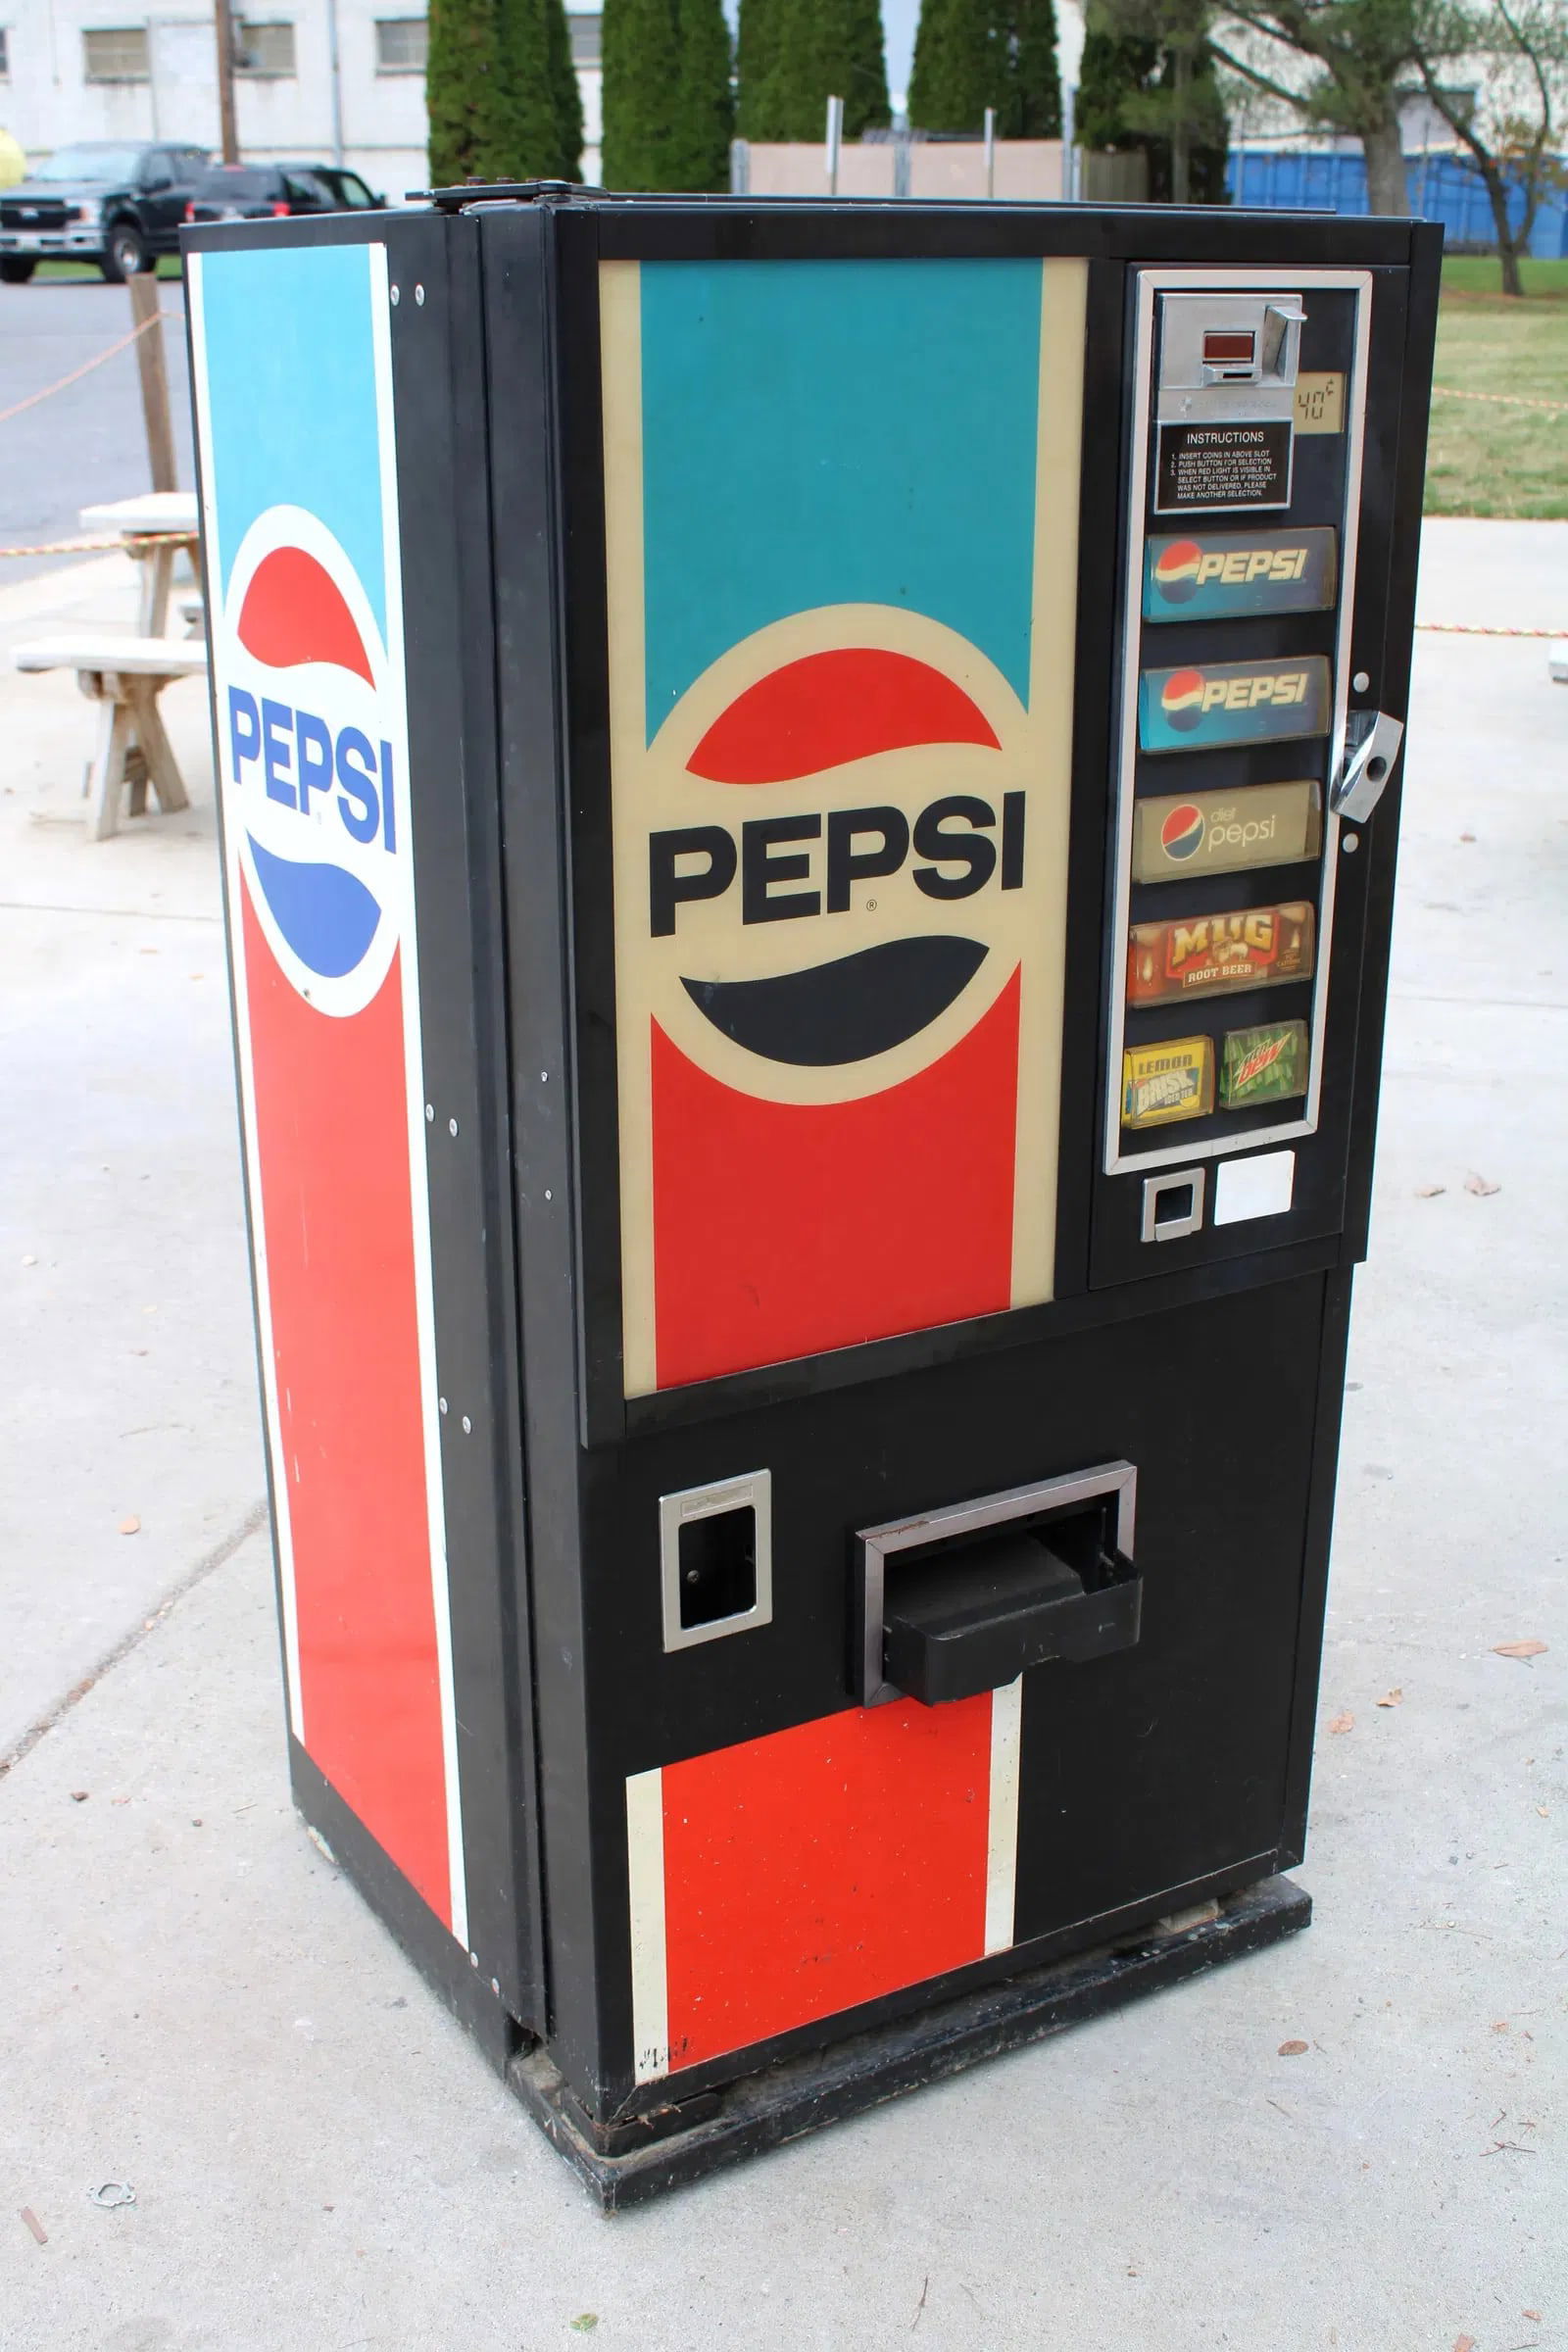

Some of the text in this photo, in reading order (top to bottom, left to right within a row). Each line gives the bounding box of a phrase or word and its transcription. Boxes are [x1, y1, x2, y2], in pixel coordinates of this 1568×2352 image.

[1187, 431, 1264, 445] INSTRUCTIONS
[1197, 459, 1223, 467] BUTTON
[1238, 458, 1272, 466] SELECTION
[1232, 450, 1252, 459] ABOVE
[1177, 475, 1201, 484] SELECT
[1230, 473, 1240, 482] OR
[1248, 472, 1277, 481] PRODUCT
[1244, 480, 1267, 489] PLEASE
[1196, 490, 1226, 499] ANOTHER
[1196, 548, 1308, 586] PEPSI
[1200, 673, 1309, 713] PEPSI
[228, 684, 397, 855] PEPSI
[1209, 807, 1237, 824] diet
[1207, 813, 1277, 854] pepsi
[649, 790, 1027, 938] PEPSI
[1171, 913, 1273, 967] MUG
[1188, 963, 1252, 983] ROOT BEER
[1138, 1054, 1193, 1076] LEMON
